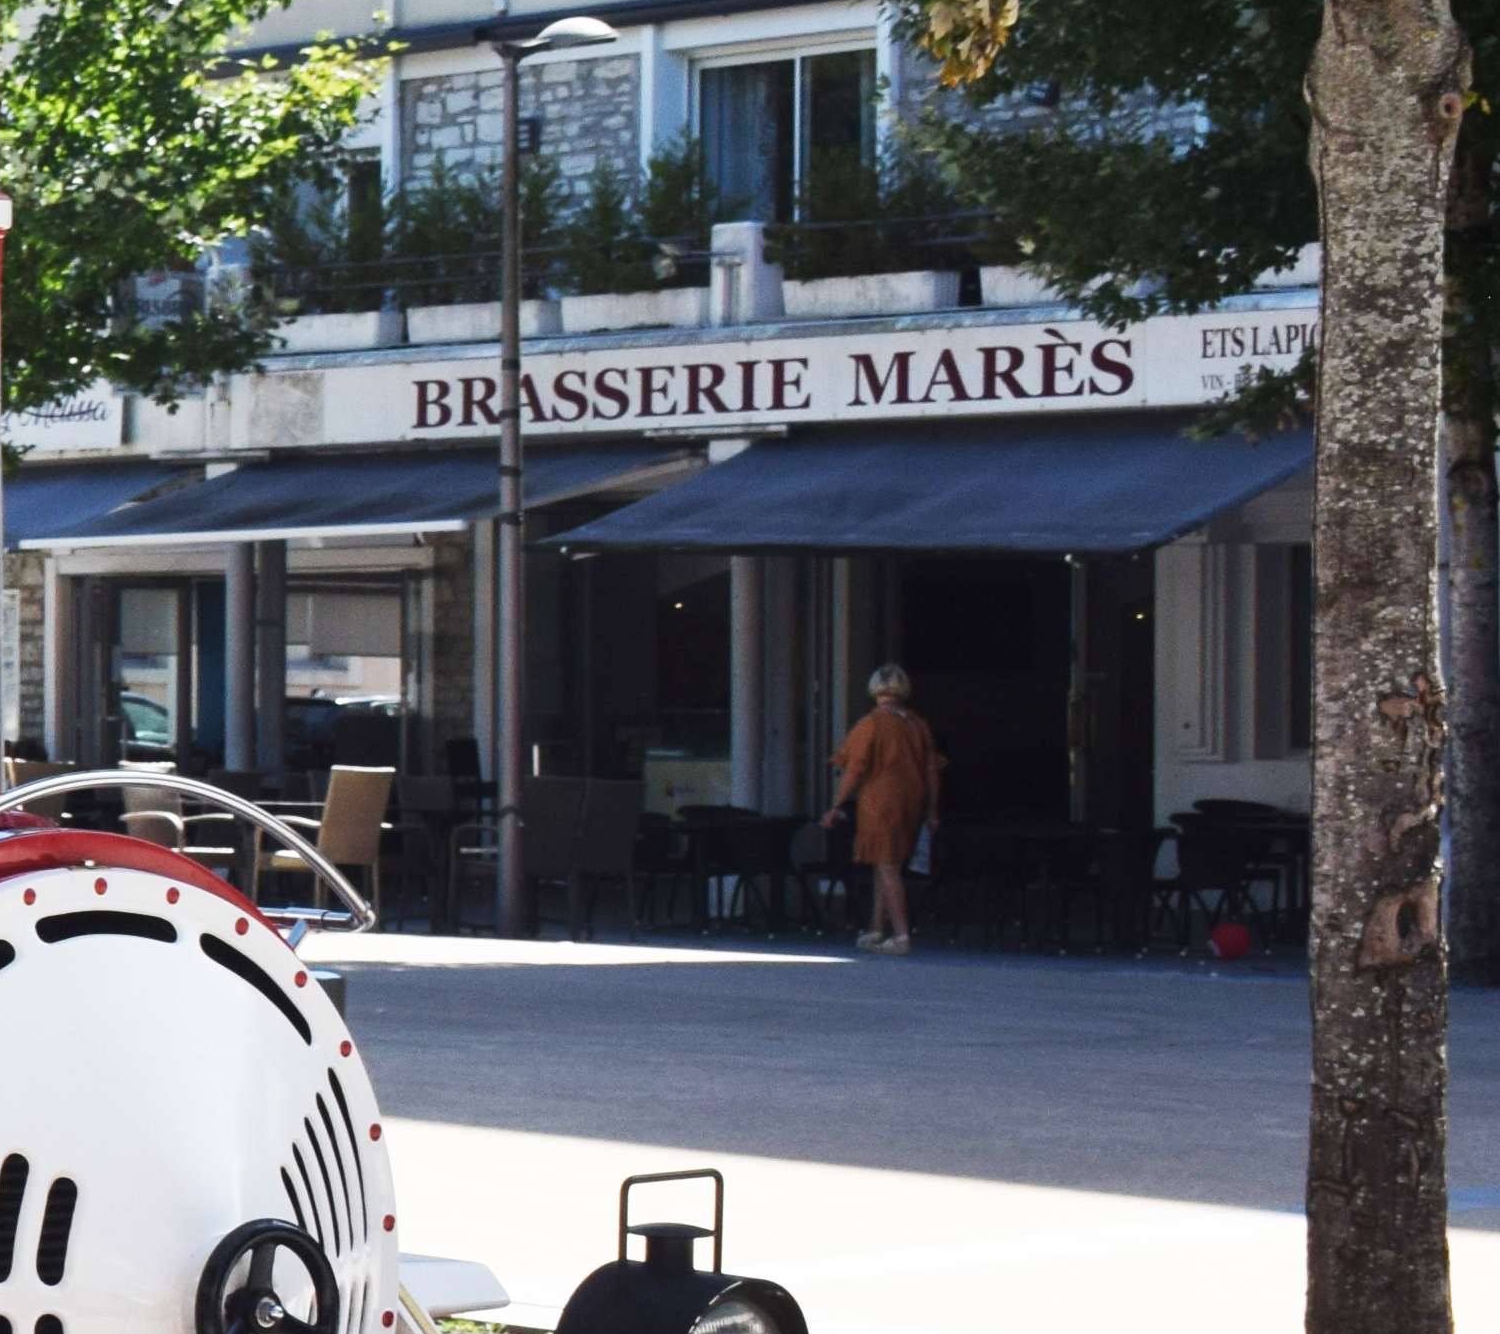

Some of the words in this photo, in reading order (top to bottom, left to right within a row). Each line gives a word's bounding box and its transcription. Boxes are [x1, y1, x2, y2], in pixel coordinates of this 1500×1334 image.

[1201, 327, 1244, 359] ETS
[412, 358, 811, 429] BRASSERIE
[848, 327, 1134, 408] MARÈS
